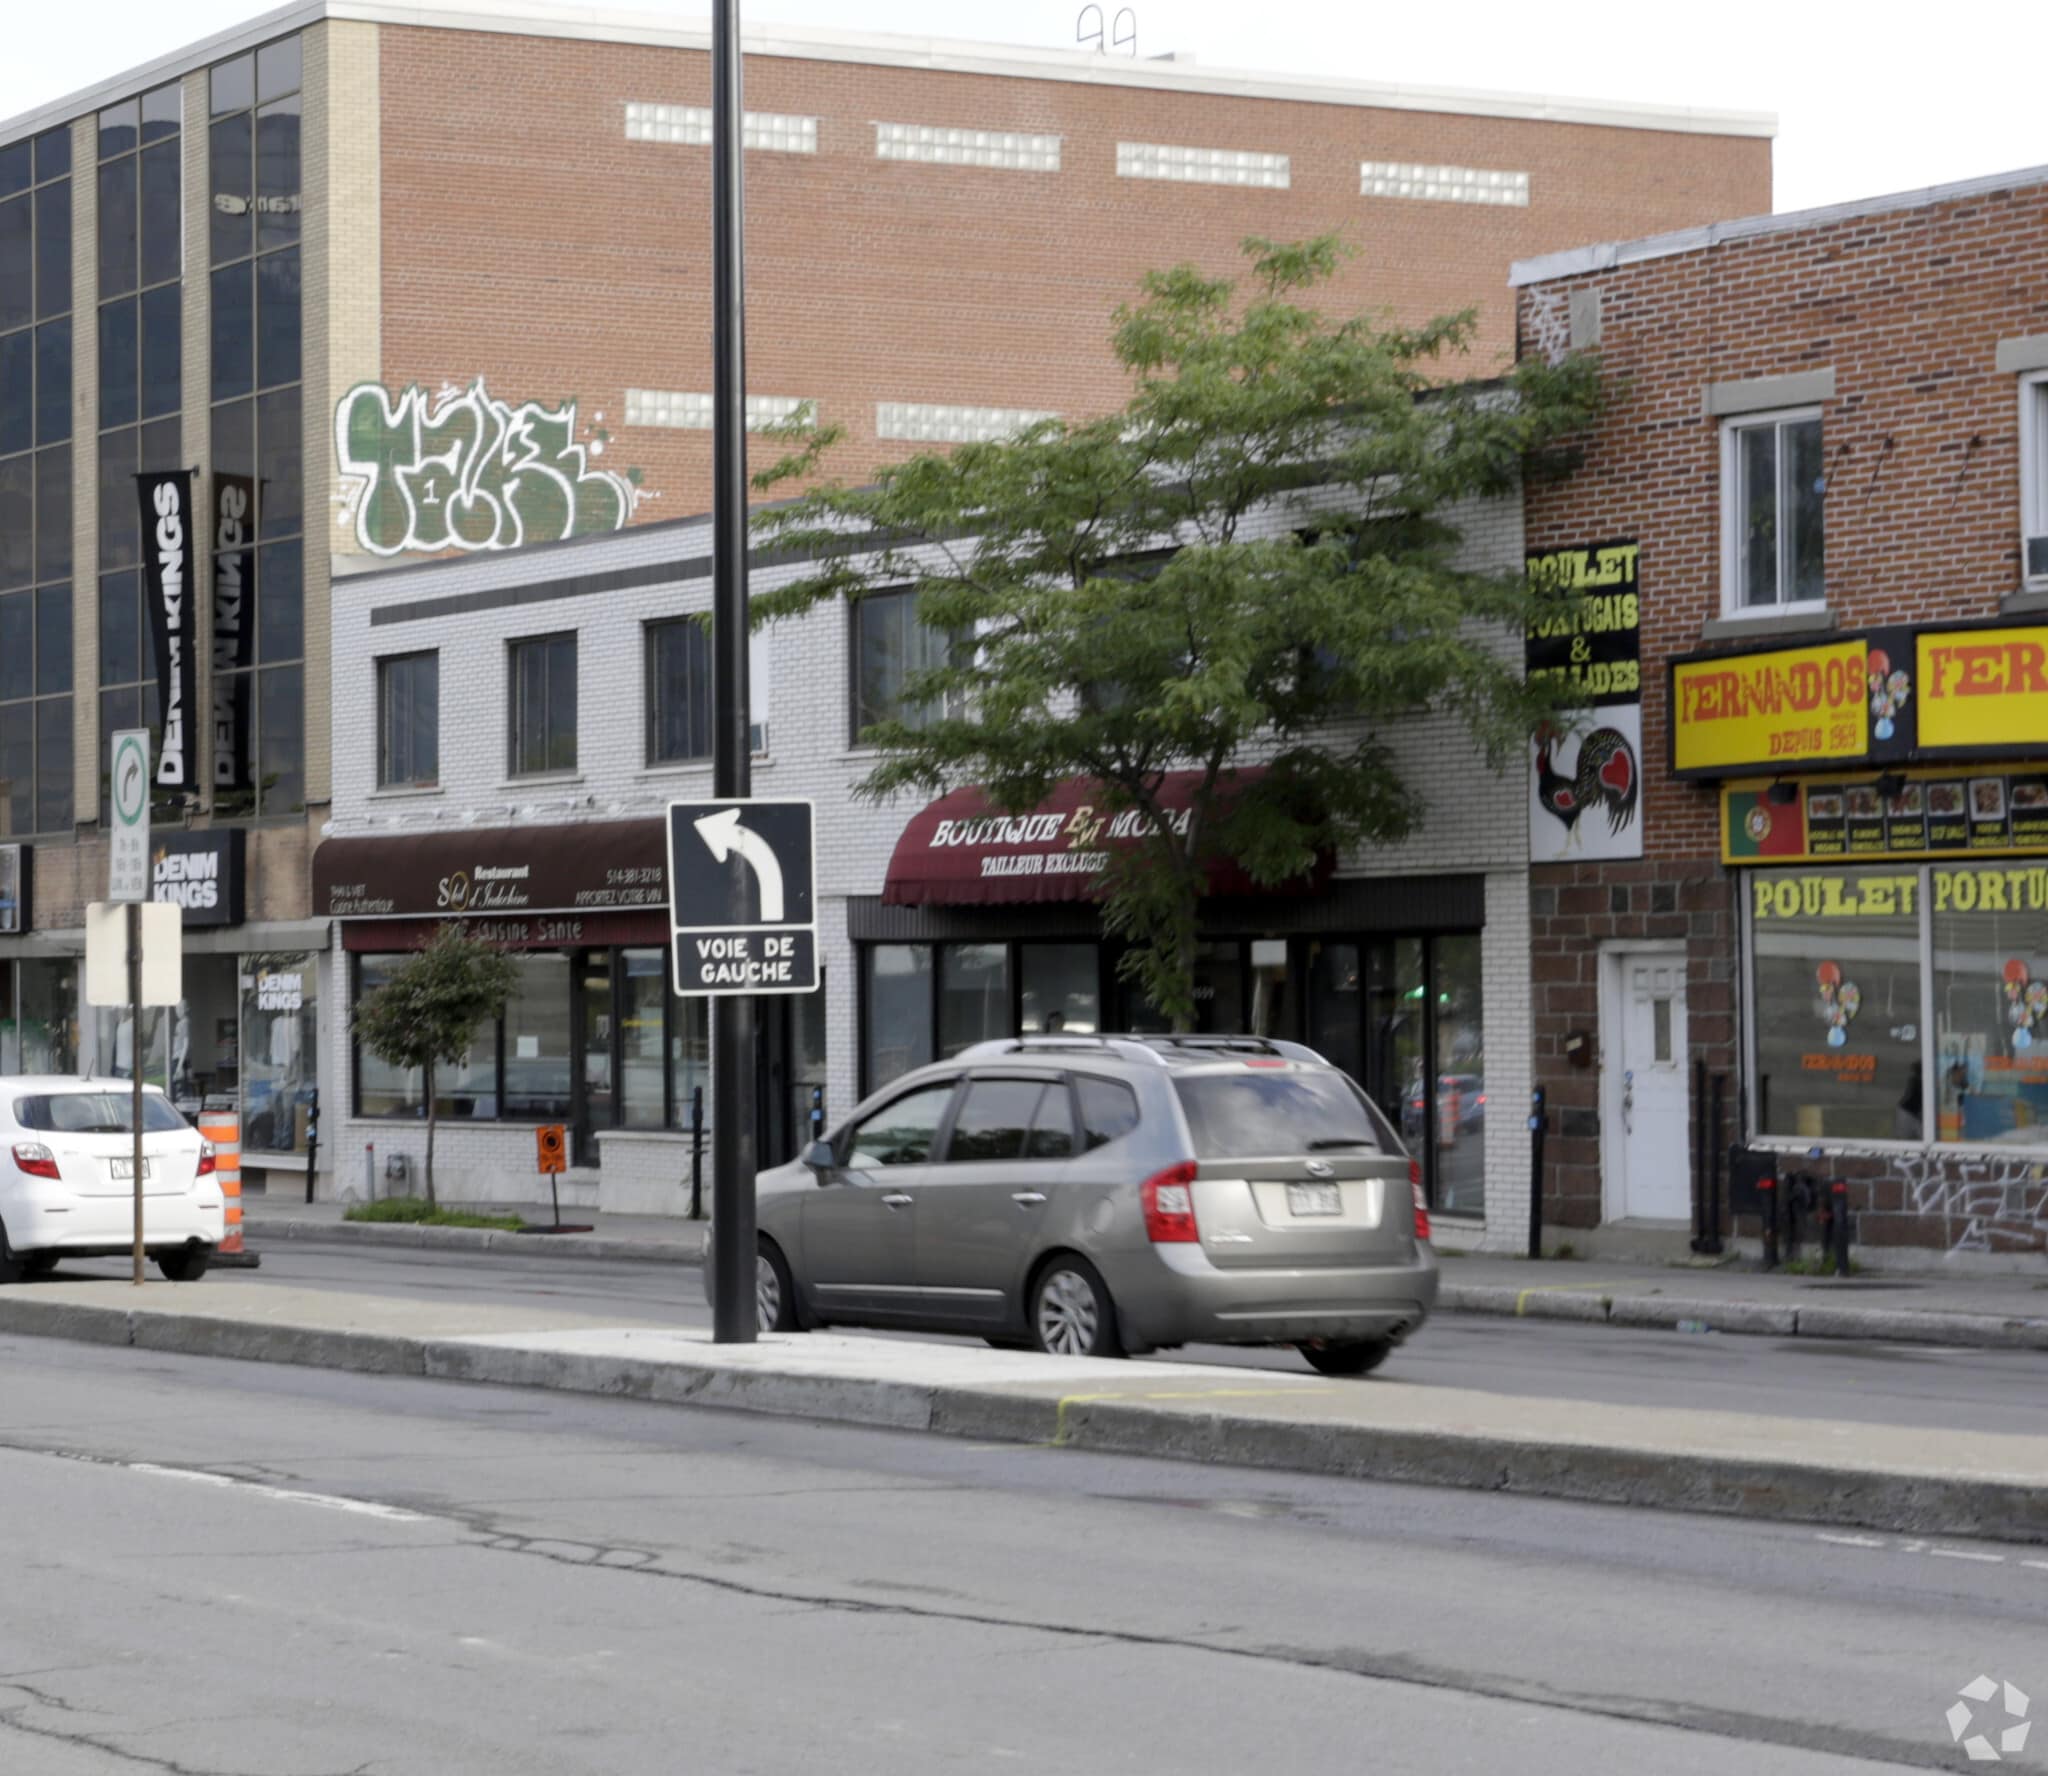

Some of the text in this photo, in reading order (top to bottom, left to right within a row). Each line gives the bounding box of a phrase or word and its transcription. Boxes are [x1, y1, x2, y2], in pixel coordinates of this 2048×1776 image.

[1526, 544, 1639, 593] POULET
[1526, 593, 1639, 640] OUGAIS
[153, 481, 184, 785] DENIM KINGS
[1570, 635, 1592, 663] &
[1528, 659, 1640, 695] LADES
[1681, 655, 1865, 724] FERNANDOS
[1769, 728, 1823, 756] DEPUIS
[929, 813, 1066, 848] BOUTIQUE
[153, 851, 218, 882] DENIM
[474, 864, 529, 880] Restaurant
[980, 855, 1043, 877] TAILLEUR
[153, 880, 218, 909] KINGS
[1754, 876, 1919, 919] POULET
[1934, 867, 2048, 912] PORTU
[696, 937, 795, 959] VOIE DE
[258, 973, 302, 993] DENIM
[700, 961, 792, 983] GAUCHE
[258, 992, 302, 1011] KINGS
